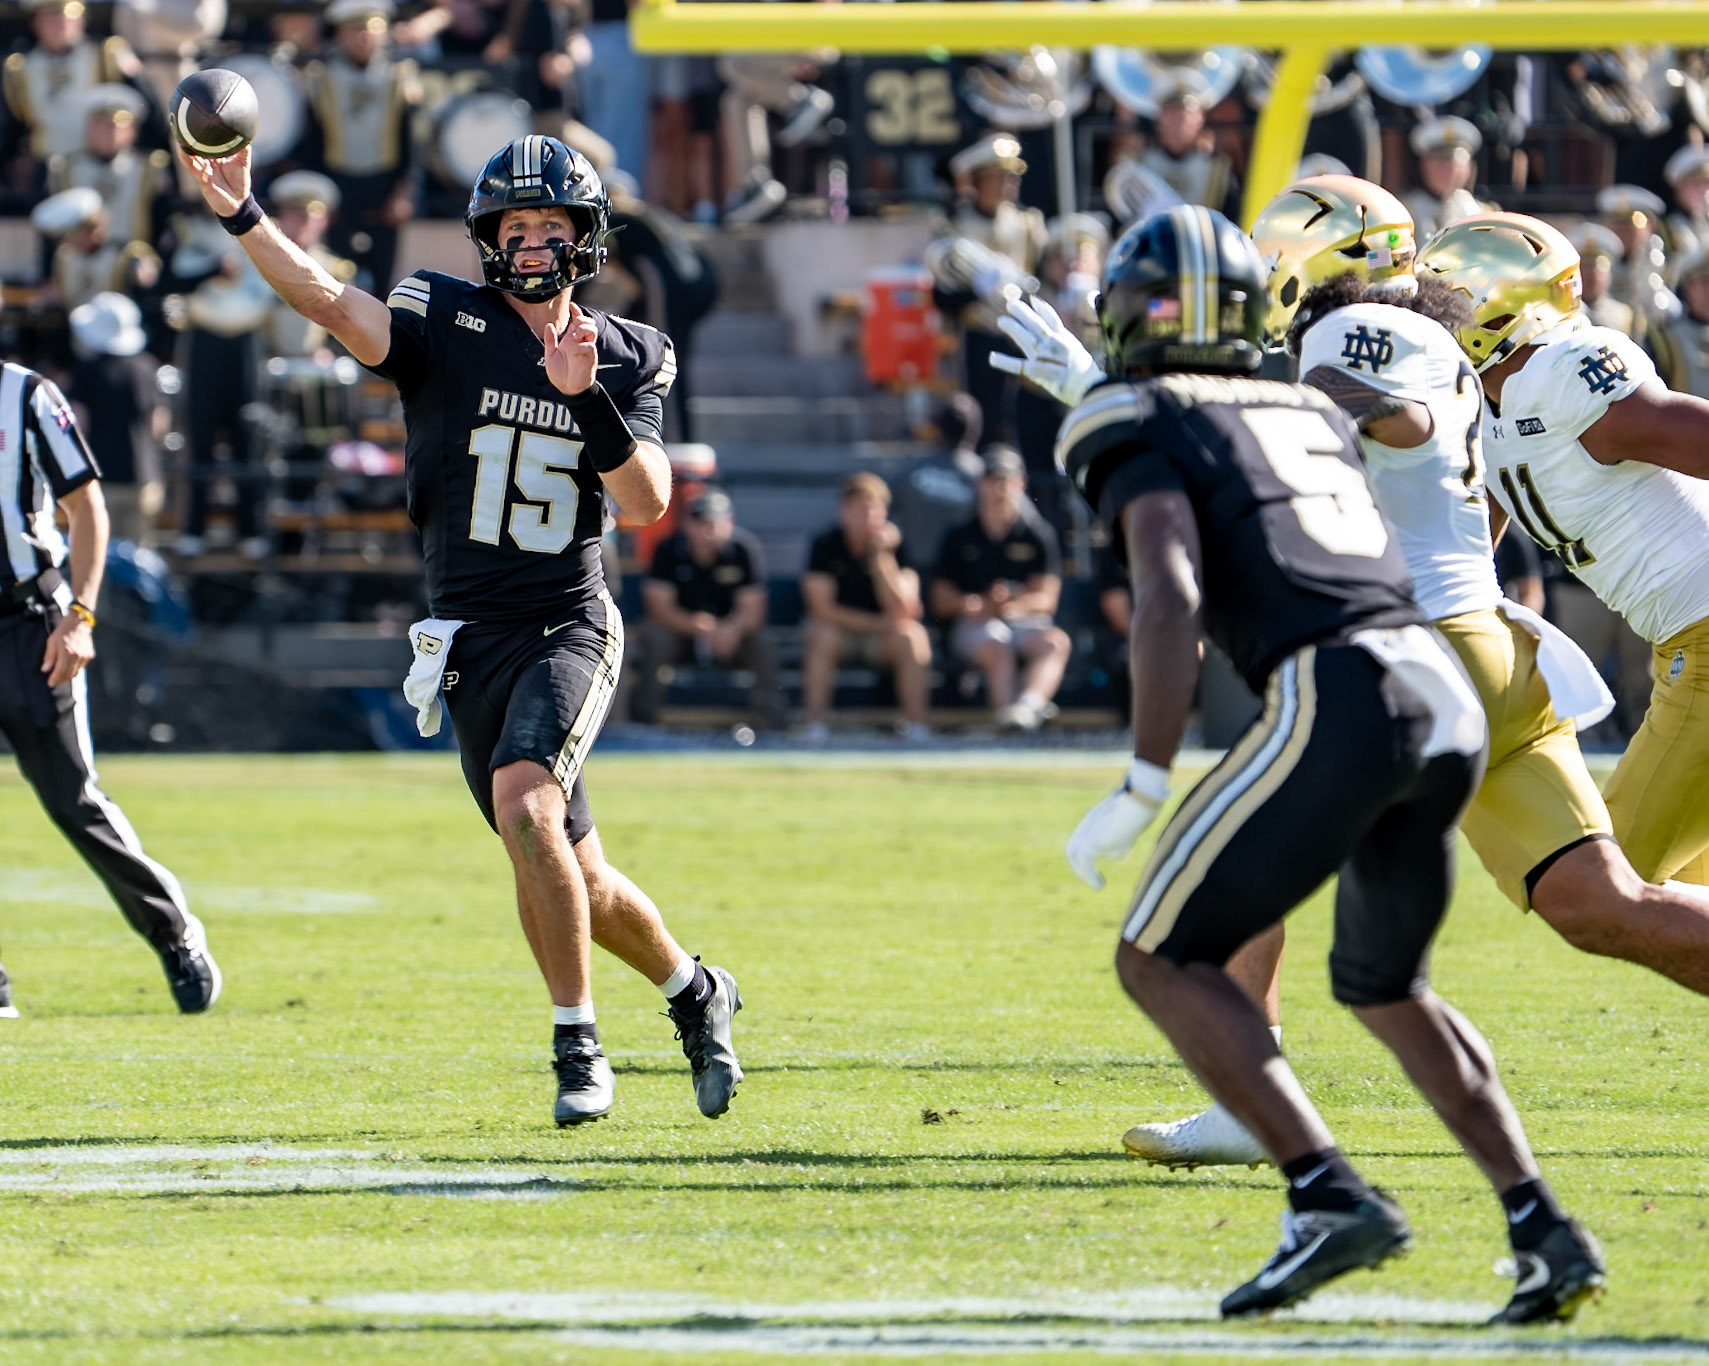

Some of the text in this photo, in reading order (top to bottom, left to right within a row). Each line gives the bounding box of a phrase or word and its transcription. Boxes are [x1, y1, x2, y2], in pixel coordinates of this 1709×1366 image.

[864, 70, 960, 144] 32
[468, 423, 585, 555] 15
[1239, 406, 1388, 559] 5
[1498, 462, 1597, 569] 11
[417, 631, 443, 656] P
[442, 670, 460, 691] P
